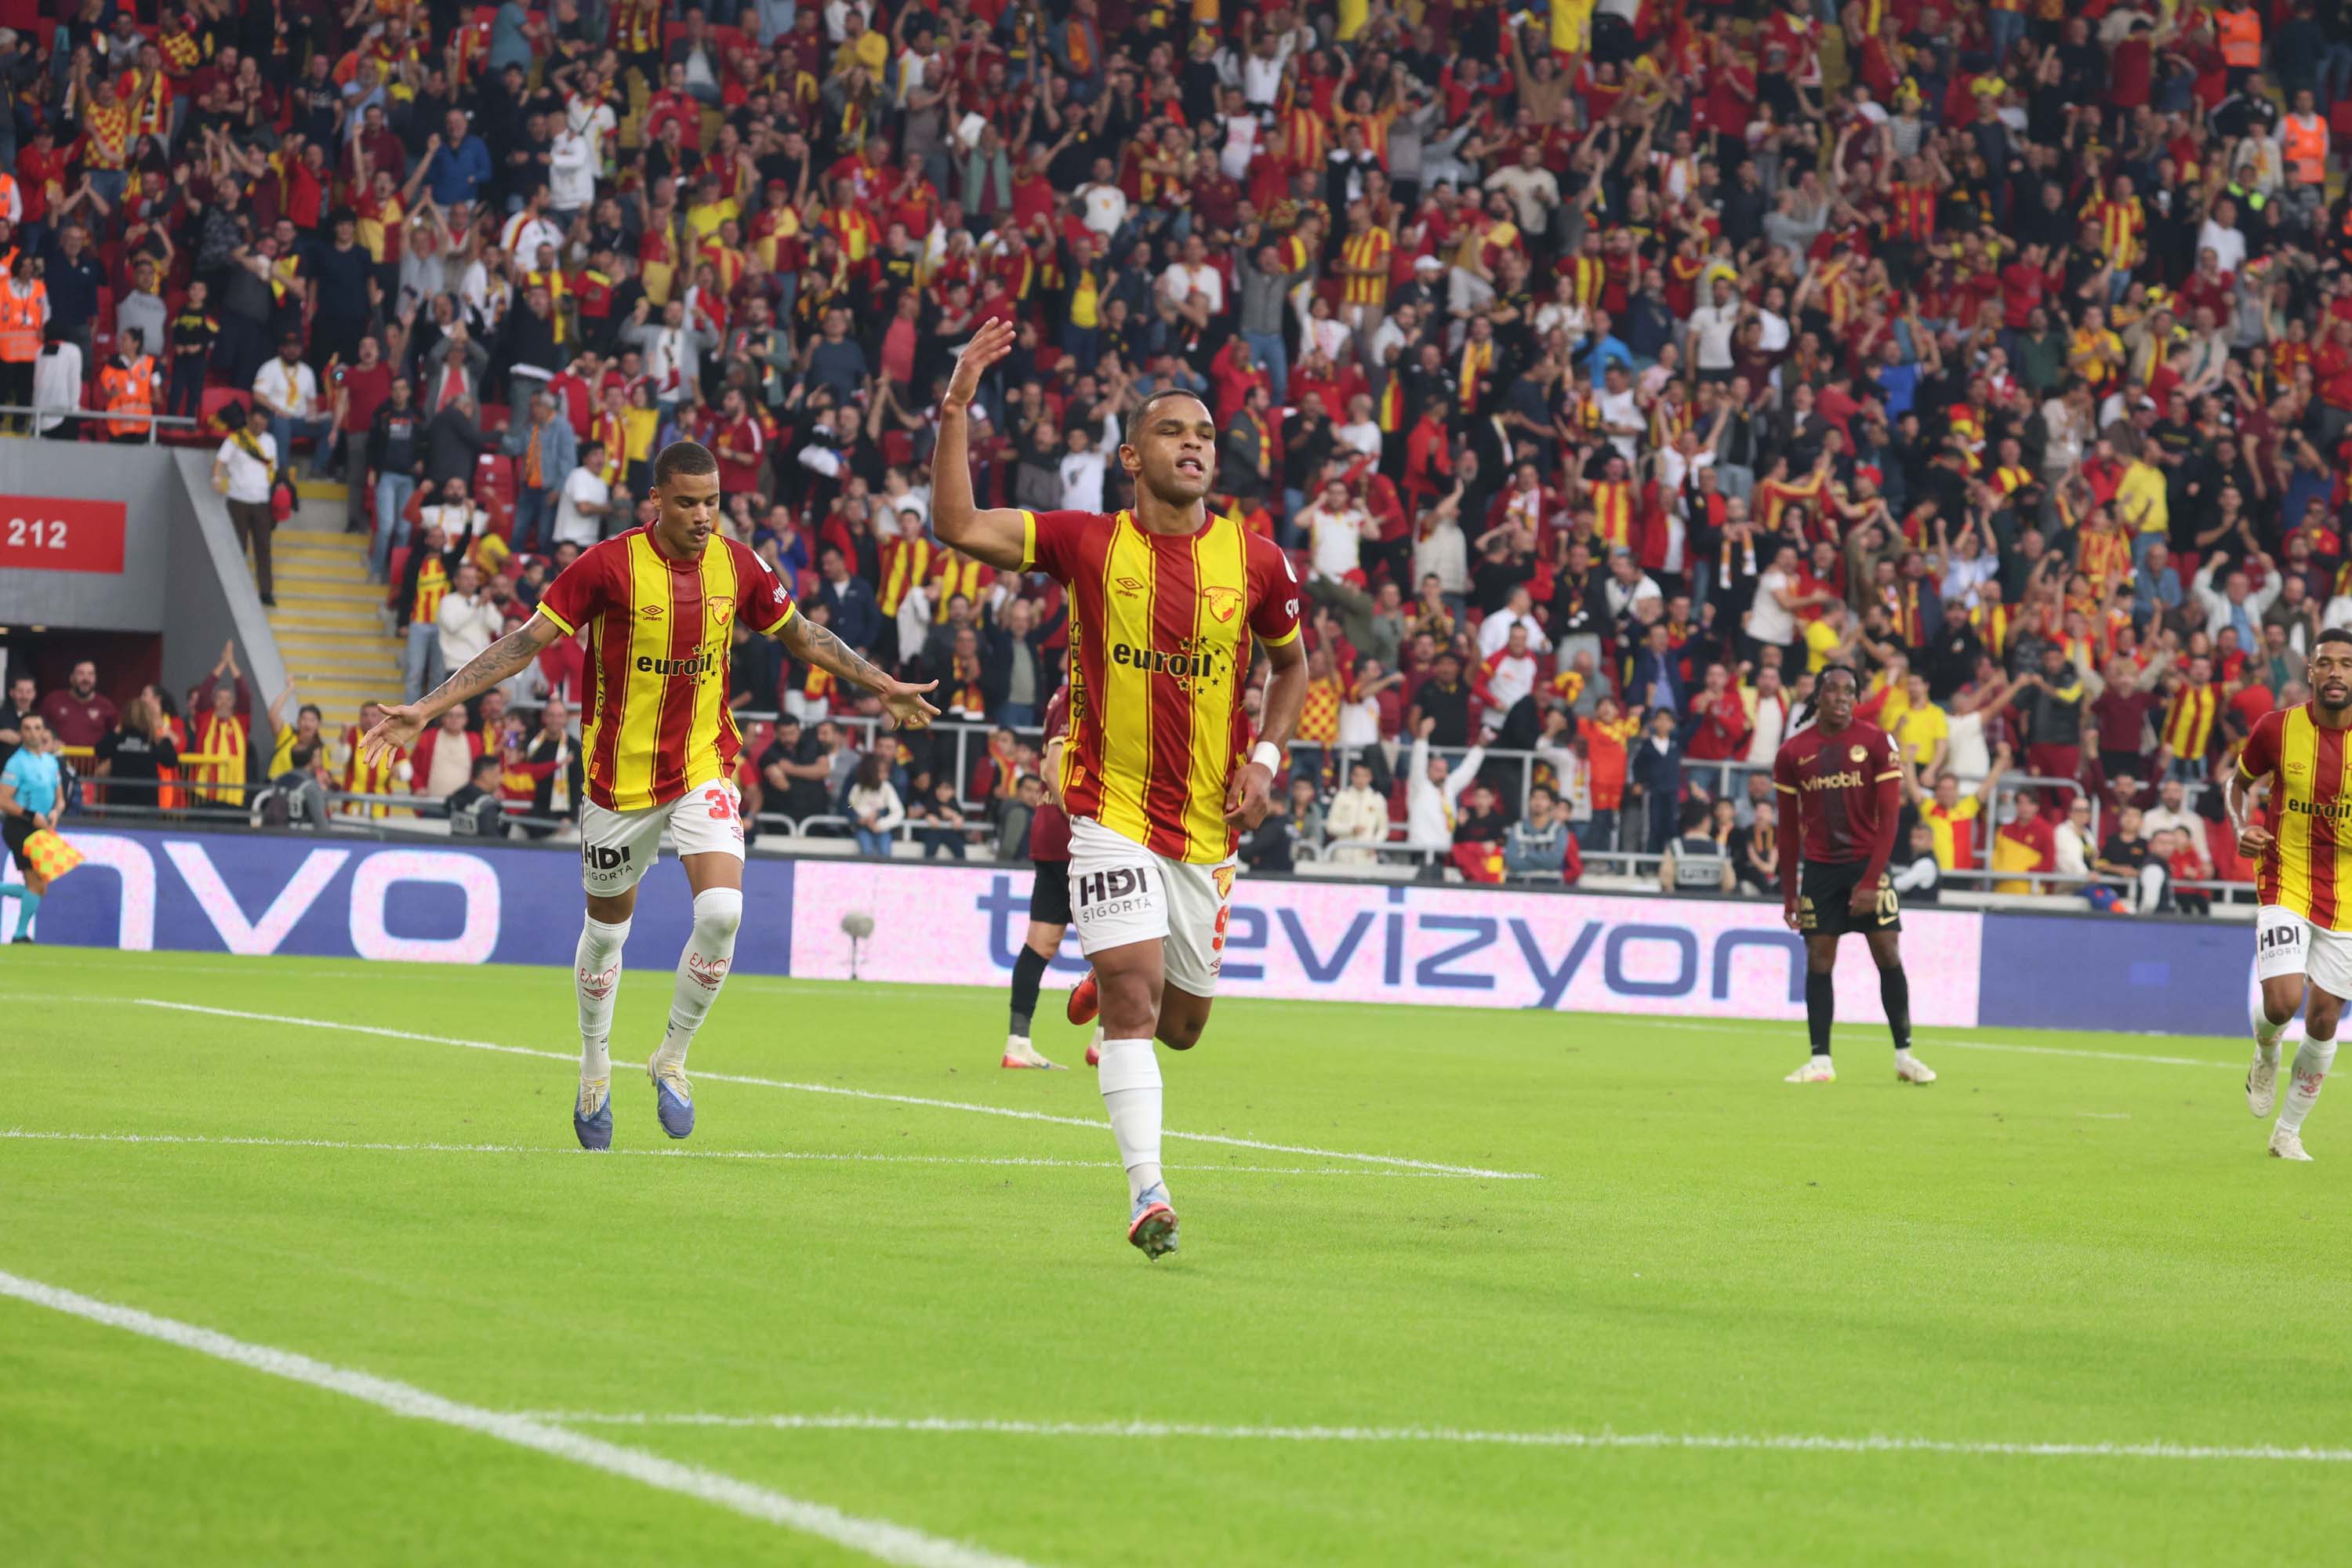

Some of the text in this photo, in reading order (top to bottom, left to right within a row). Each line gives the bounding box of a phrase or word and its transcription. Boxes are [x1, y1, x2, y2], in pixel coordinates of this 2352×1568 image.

[7, 517, 67, 549] 212
[637, 653, 713, 676] euroil
[1112, 642, 1212, 677] euroil
[2288, 799, 2351, 818] euroil
[584, 840, 630, 869] HDI
[1080, 867, 1147, 907] HDI
[1212, 904, 1230, 952] 9
[2260, 926, 2299, 951] HDI
